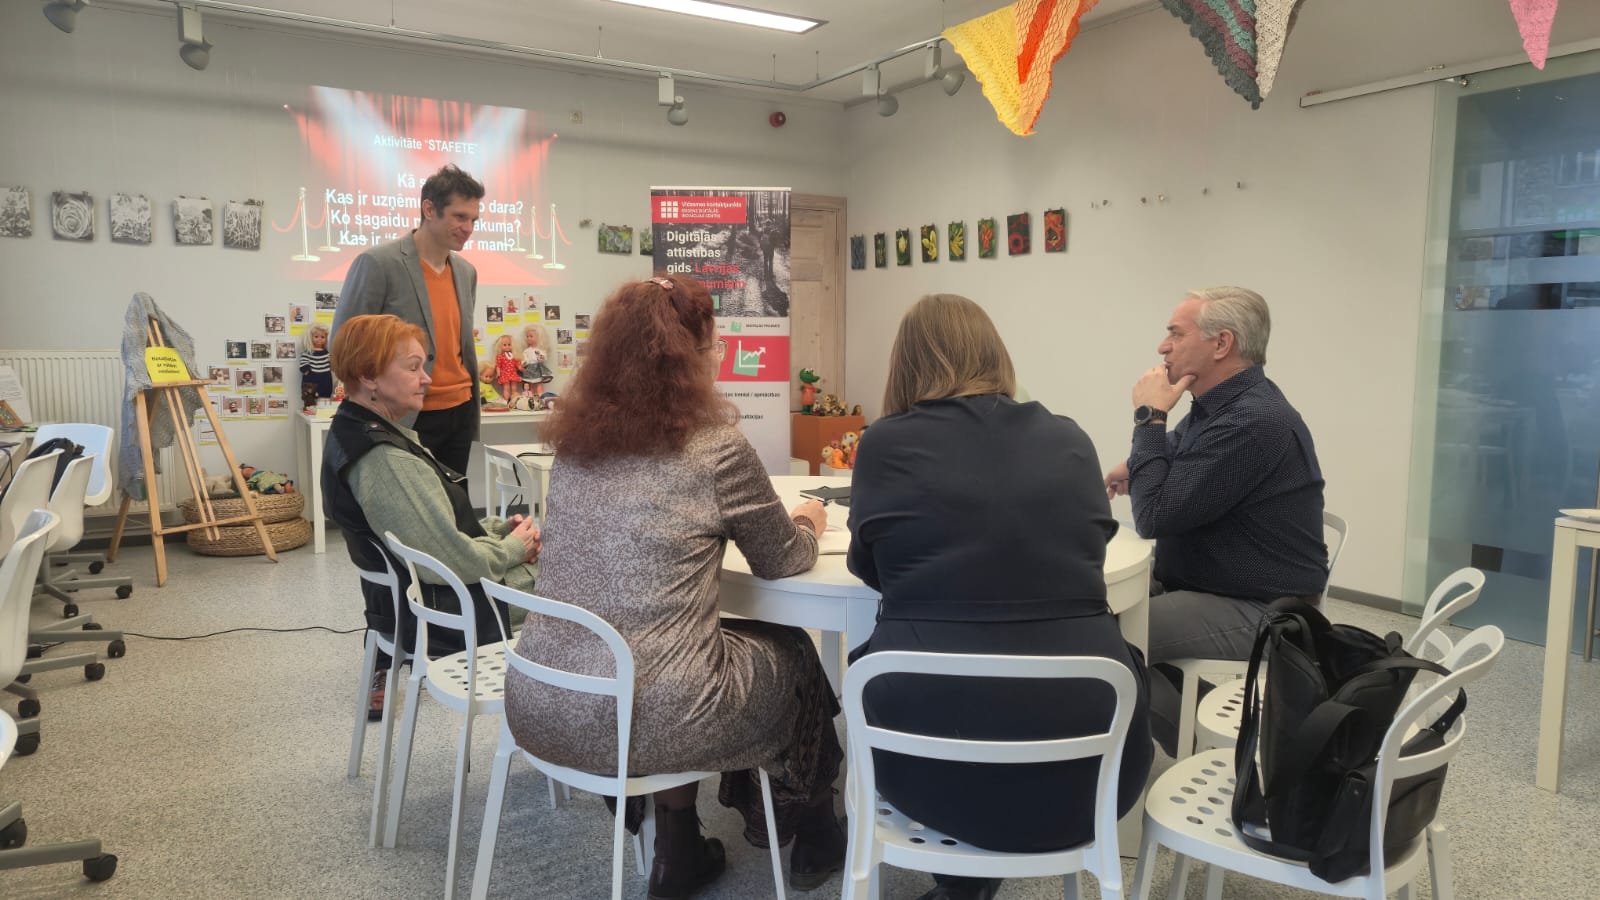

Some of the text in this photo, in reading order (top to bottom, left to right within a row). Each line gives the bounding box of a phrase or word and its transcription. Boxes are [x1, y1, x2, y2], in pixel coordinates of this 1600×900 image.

[373, 134, 422, 149] Aktivitāte
[397, 172, 416, 188] Kā
[326, 189, 353, 204] Kas
[357, 190, 368, 206] ir
[488, 200, 523, 214] dara?
[330, 209, 351, 224] Ko
[355, 212, 409, 229] sagaidu
[340, 230, 367, 246] Kas
[371, 232, 381, 246] ir
[477, 239, 515, 252] mani?
[666, 262, 740, 276] gids Latvijas
